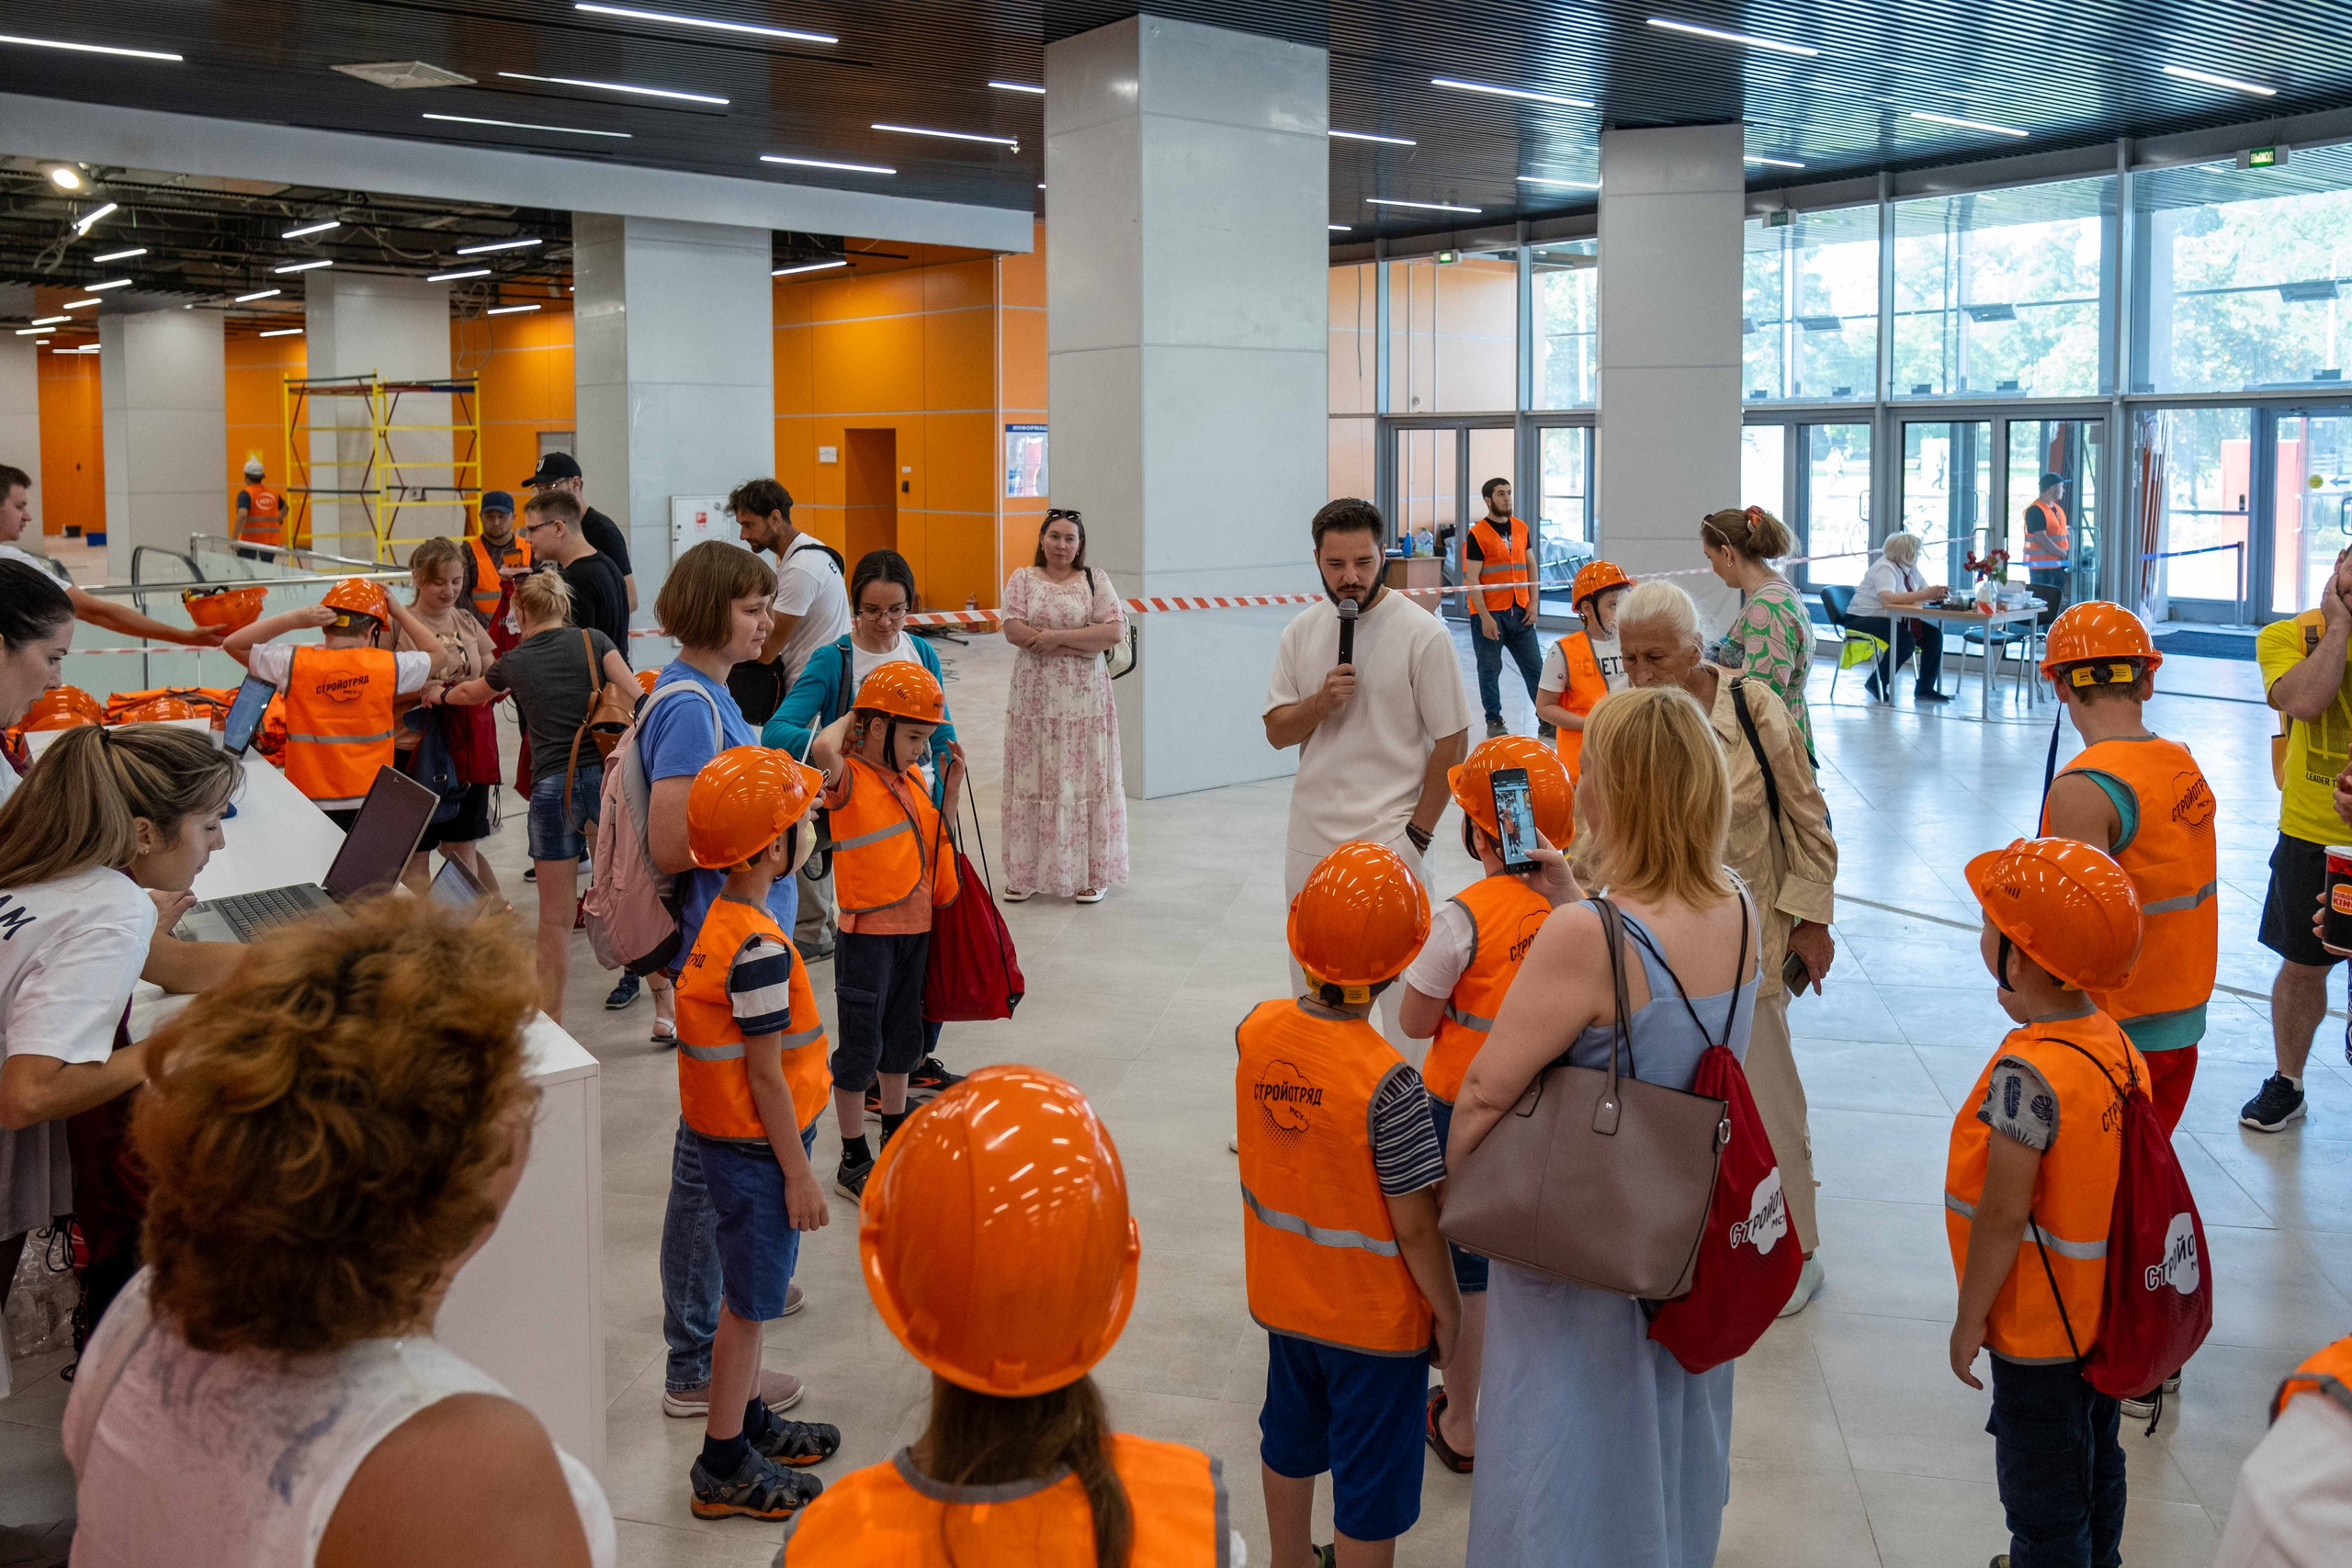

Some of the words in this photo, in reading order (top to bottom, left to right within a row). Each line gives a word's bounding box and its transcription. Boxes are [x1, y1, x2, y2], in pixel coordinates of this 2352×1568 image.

[2250, 151, 2274, 164] ВЫХОД
[315, 675, 369, 694] СТРОЙОТРЯД
[2306, 772, 2330, 786] LEADER
[2334, 891, 2352, 901] BURG
[2334, 897, 2352, 908] KIN
[1253, 1080, 1323, 1107] СТРОЙОТРЯД
[1289, 1105, 1308, 1124] МСУ-1
